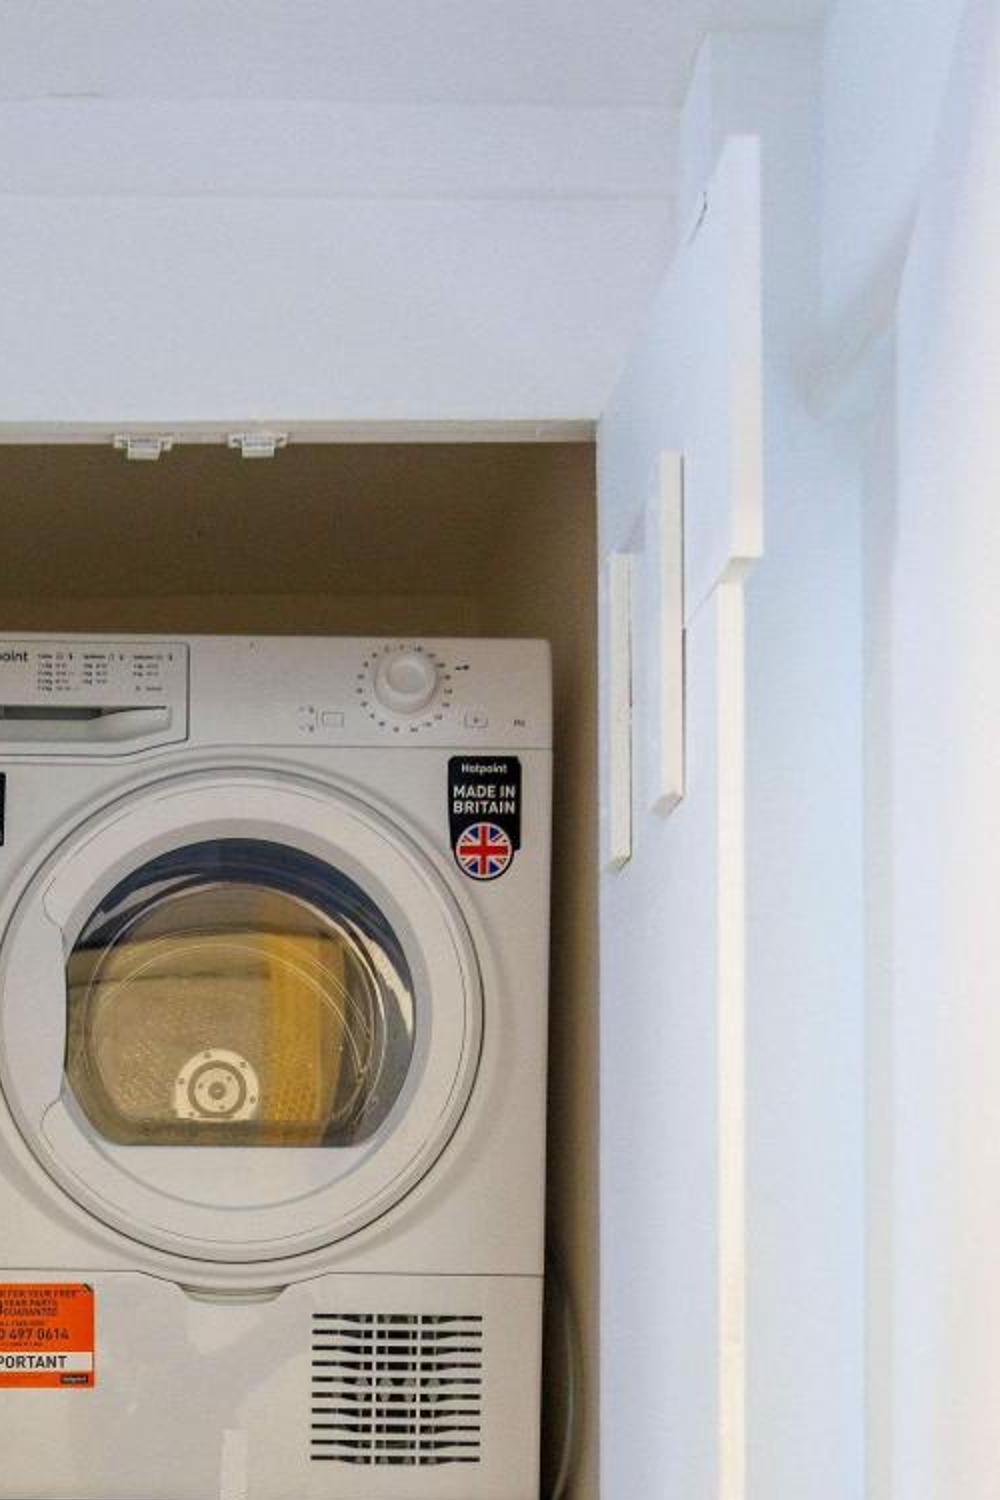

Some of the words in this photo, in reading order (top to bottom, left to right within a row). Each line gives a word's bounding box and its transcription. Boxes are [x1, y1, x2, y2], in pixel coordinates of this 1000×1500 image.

[461, 763, 508, 775] Hotpoint
[453, 785, 496, 799] MADE
[500, 785, 516, 799] IN
[453, 801, 515, 814] BRITAIN
[9, 1328, 34, 1340] 497
[37, 1328, 69, 1341] 0614
